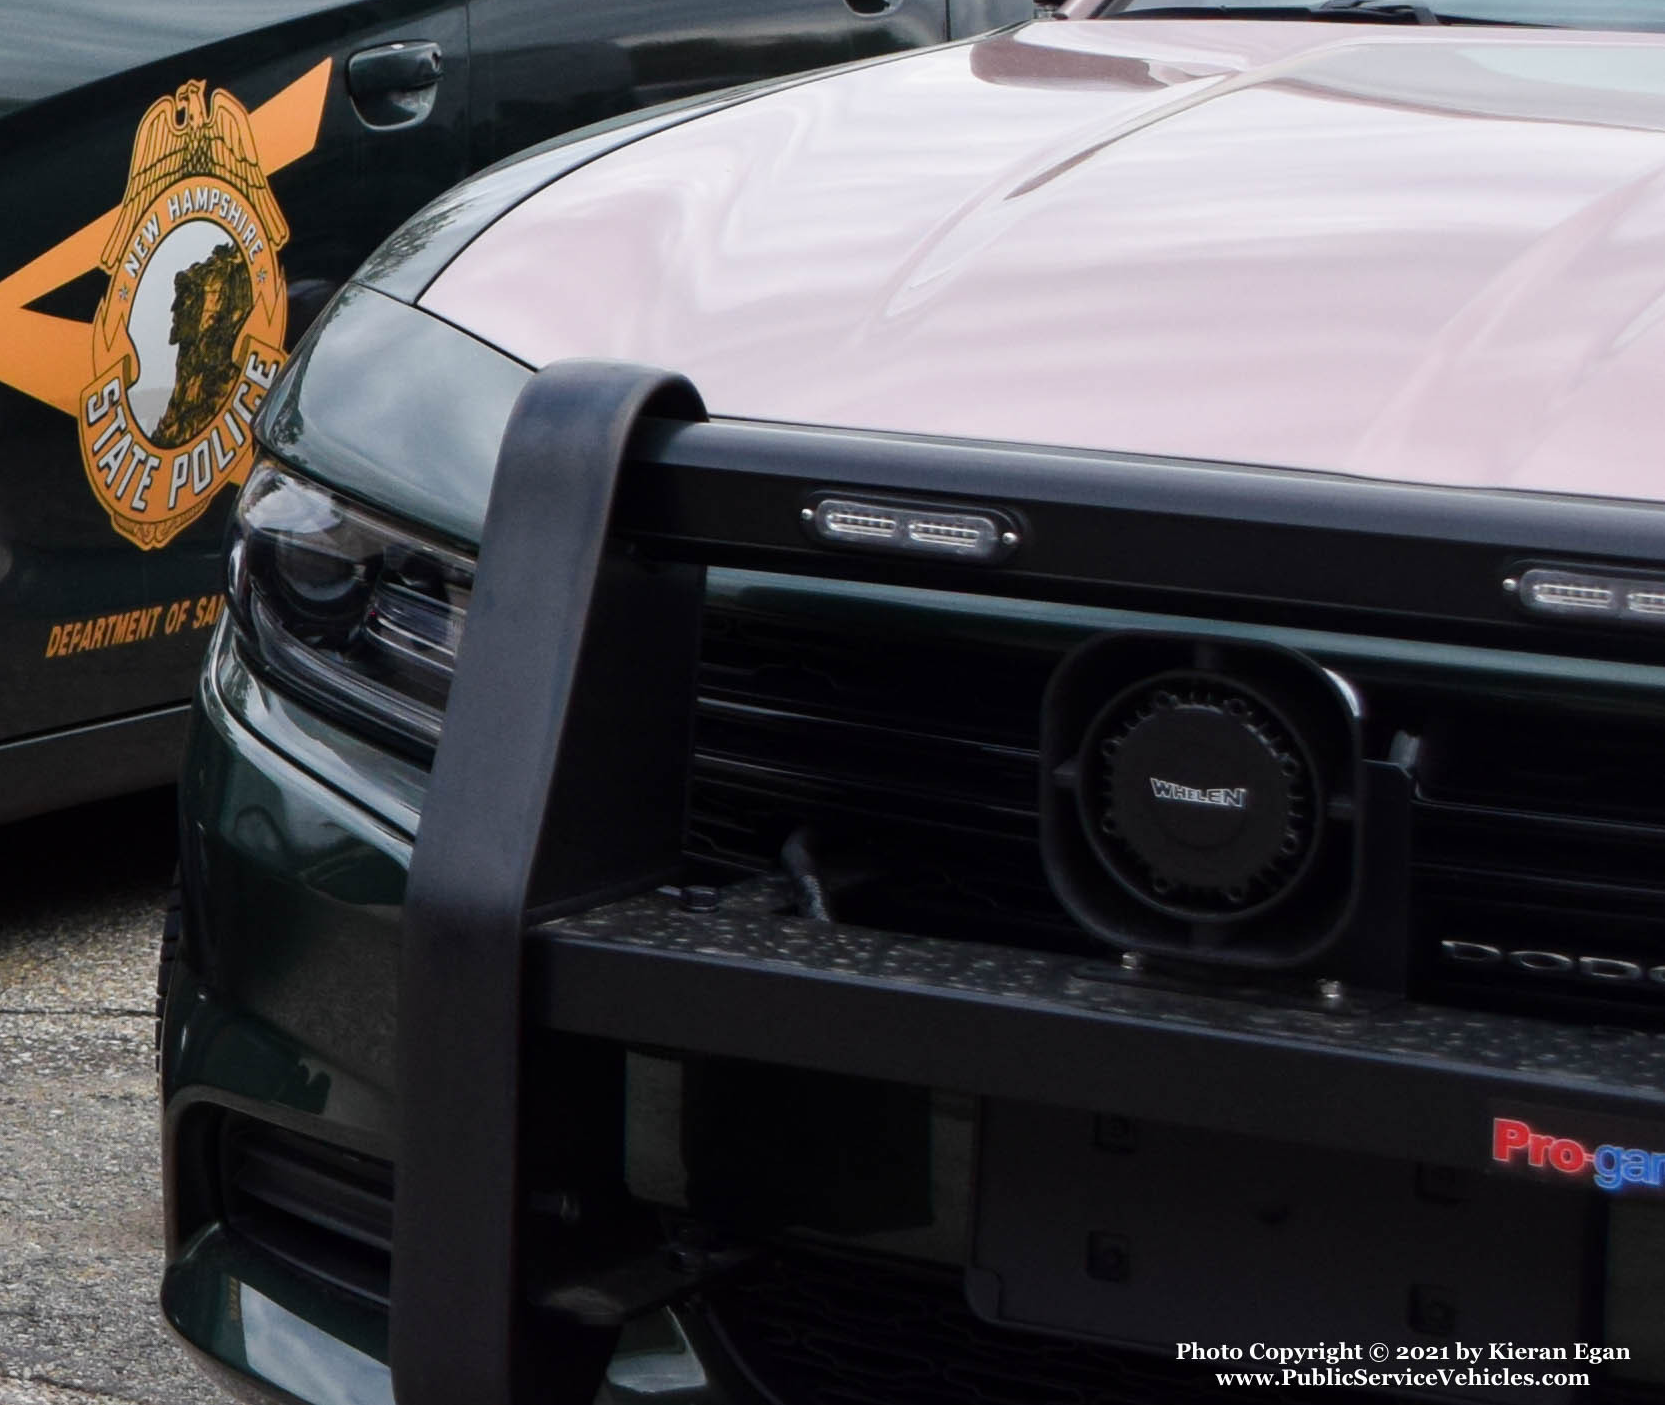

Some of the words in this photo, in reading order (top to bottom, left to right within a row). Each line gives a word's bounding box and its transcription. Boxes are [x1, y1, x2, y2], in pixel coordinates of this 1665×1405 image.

[124, 212, 161, 279] NEW
[167, 186, 264, 264] HAMPSHIRE
[86, 376, 163, 512] STATE
[167, 350, 281, 510] POLICE
[45, 606, 163, 659] DEPARTMENT
[164, 599, 191, 635] OF
[1150, 777, 1248, 808] WHELEN
